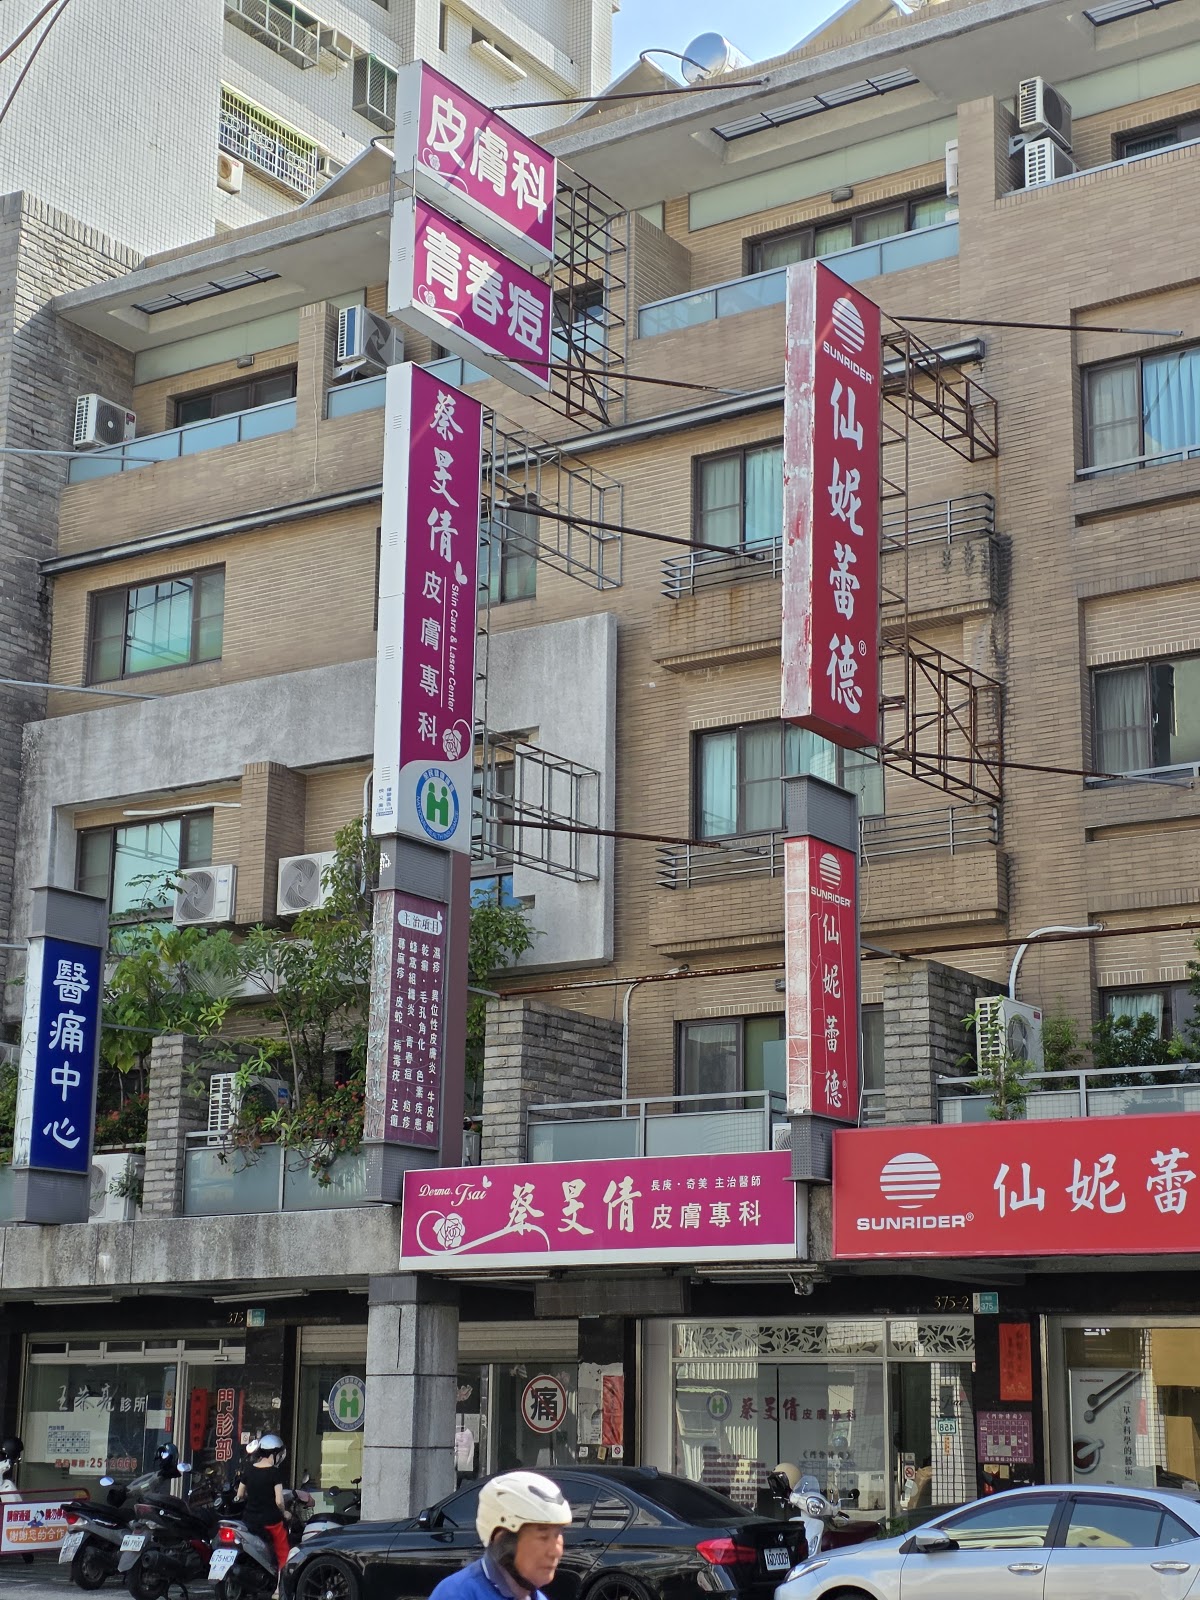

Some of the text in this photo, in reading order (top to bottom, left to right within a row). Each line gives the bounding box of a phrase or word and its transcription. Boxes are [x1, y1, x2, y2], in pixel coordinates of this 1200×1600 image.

[426, 94, 548, 224] 皮膚科
[423, 226, 544, 356] 青春痘
[447, 584, 459, 712] Skin Care & Laser Center
[810, 886, 851, 908] SUNRIDER
[403, 911, 440, 933] 主治項目
[43, 959, 90, 1149] 醫痛中心
[450, 1183, 487, 1207] Tsai
[714, 1175, 762, 1190] 主治醫師
[993, 1147, 1197, 1219] 仙妮蕾
[503, 1175, 643, 1236] 蔡旻倩
[650, 1200, 762, 1231] 皮膚專科
[227, 1311, 244, 1324] 375
[934, 1295, 970, 1310] 375-2
[981, 1302, 994, 1310] 375
[530, 1386, 558, 1422] 痛
[215, 1388, 235, 1463] 門診部
